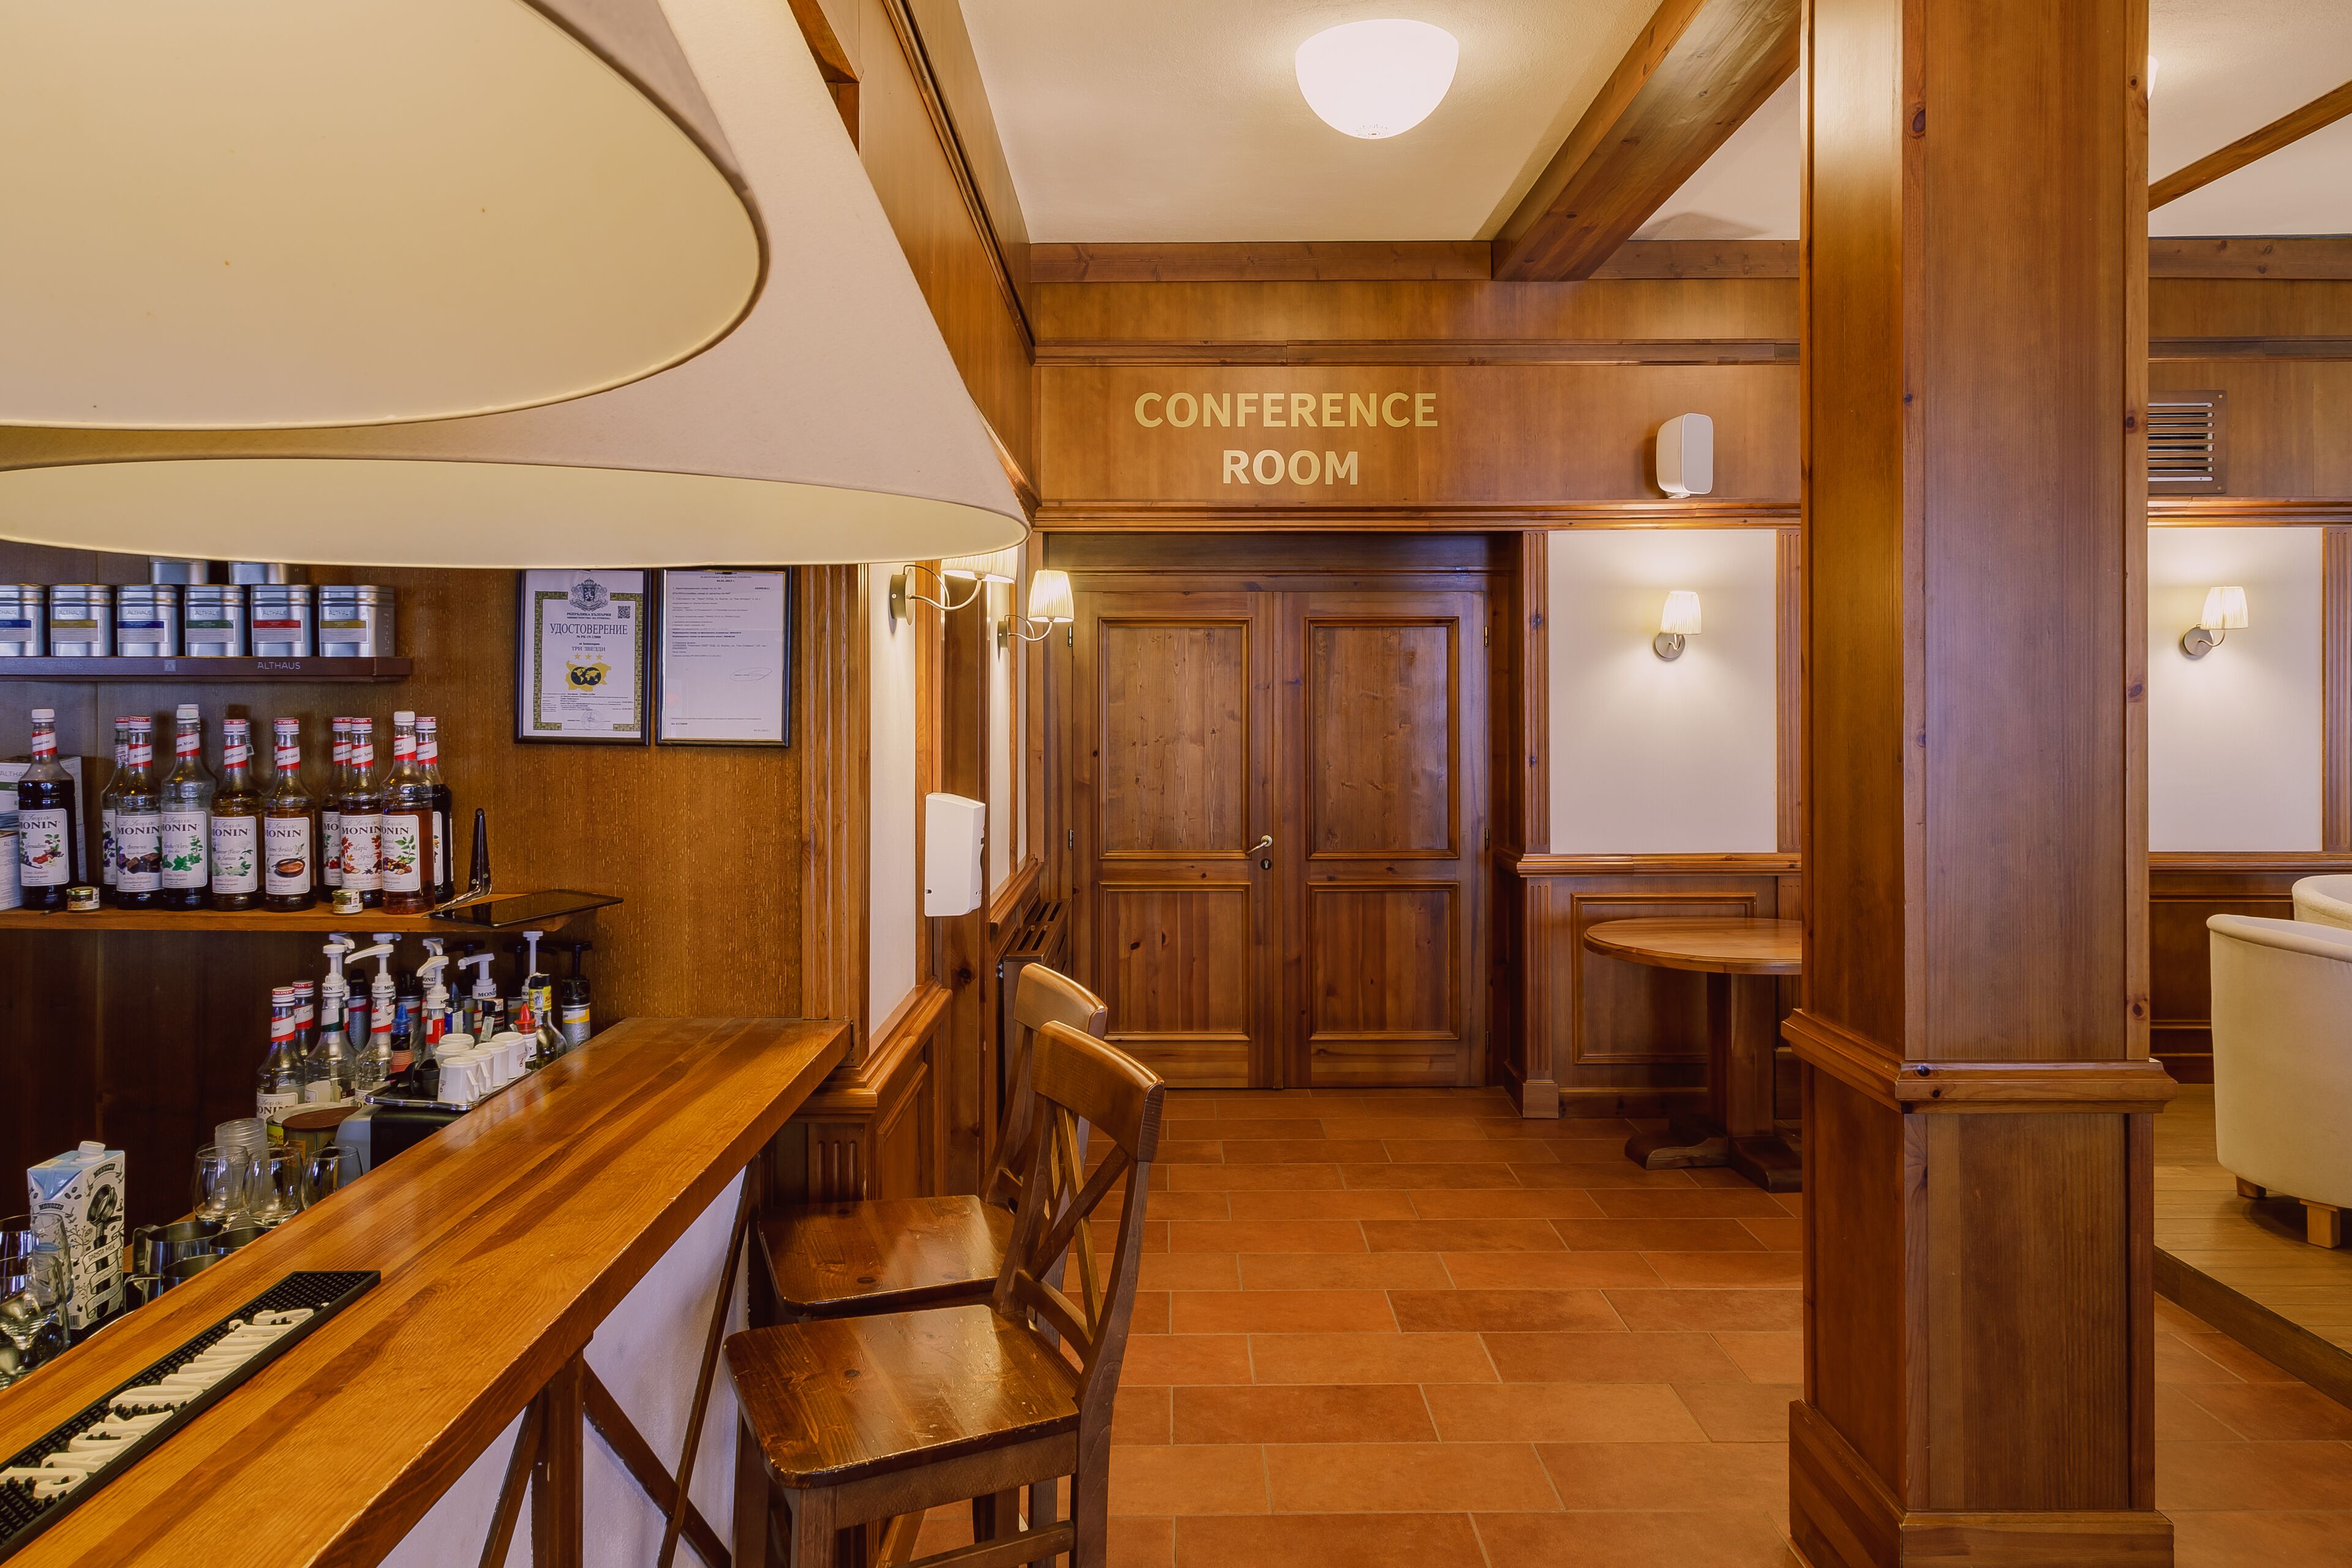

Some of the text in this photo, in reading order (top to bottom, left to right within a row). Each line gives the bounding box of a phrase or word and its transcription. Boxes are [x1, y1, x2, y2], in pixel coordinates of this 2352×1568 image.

[1134, 392, 1438, 428] CONFERENCE
[1223, 449, 1359, 486] ROOM
[550, 624, 628, 635] УДОСТОВЕРЕНИЕ
[118, 826, 159, 835] MONIN
[342, 826, 381, 835] MONIN
[352, 843, 368, 853] Maple
[358, 852, 373, 861] Spice
[258, 1106, 284, 1114] ONI
[88, 1242, 116, 1262] BARISTA MILK
[0, 1410, 174, 1499] JACK
